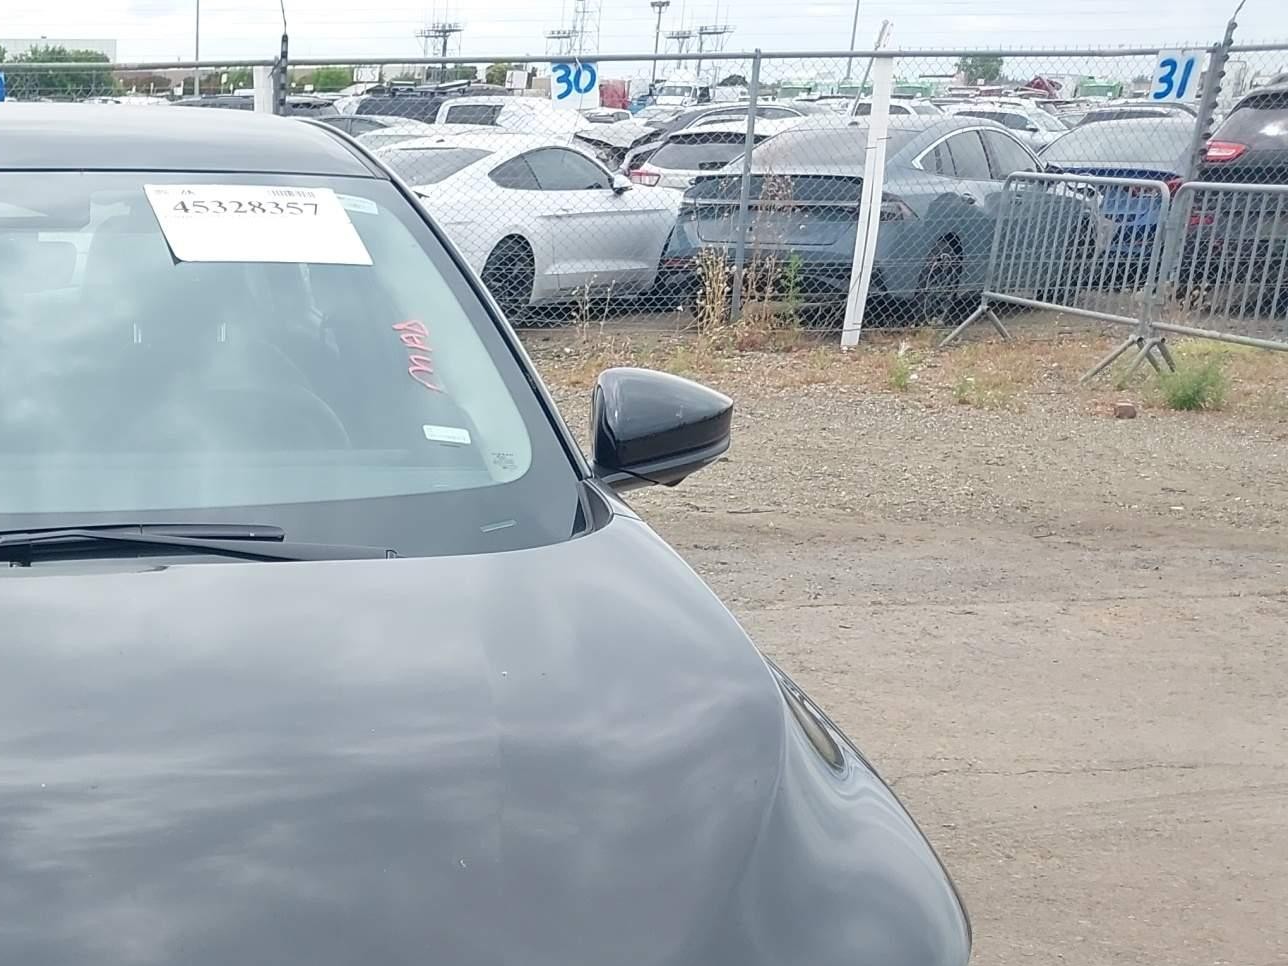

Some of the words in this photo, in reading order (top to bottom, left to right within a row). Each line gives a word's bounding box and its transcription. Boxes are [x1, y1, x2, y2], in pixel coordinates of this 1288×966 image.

[552, 63, 596, 100] 30
[1153, 58, 1195, 99] 31
[172, 200, 318, 216] 45328357
